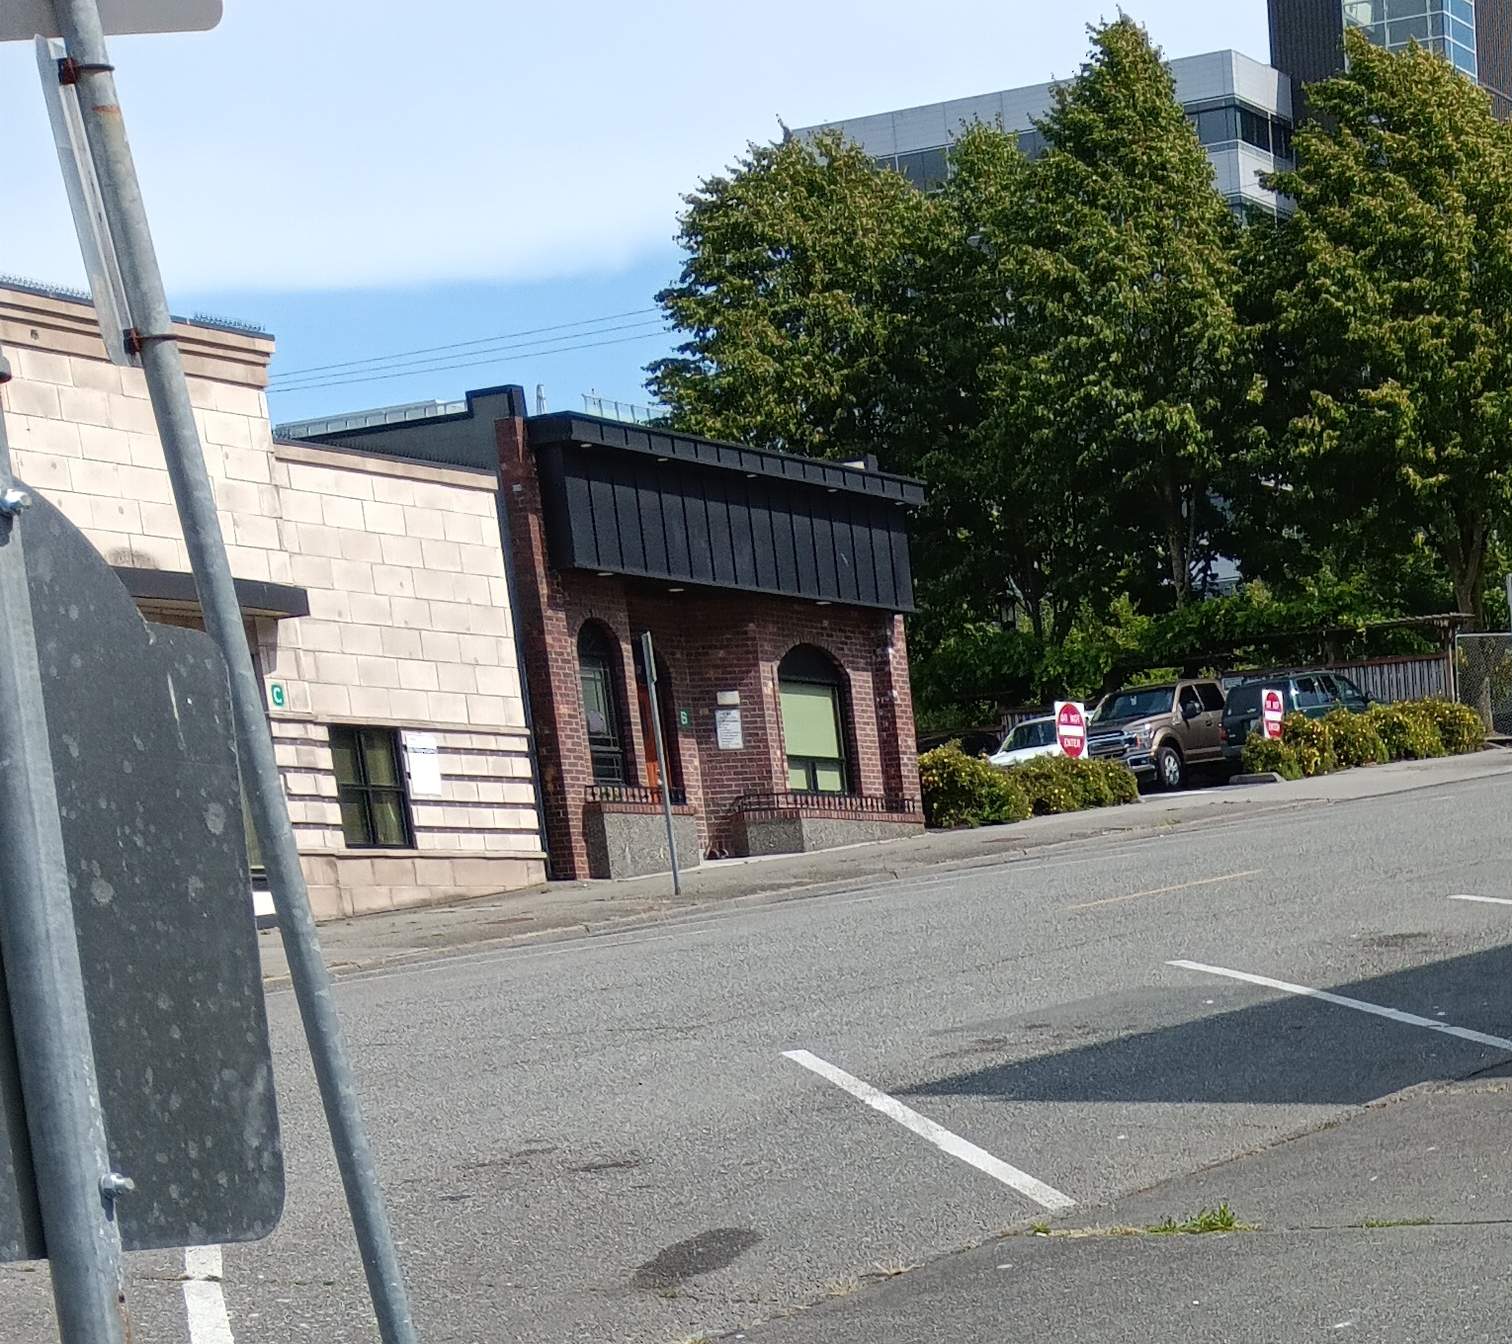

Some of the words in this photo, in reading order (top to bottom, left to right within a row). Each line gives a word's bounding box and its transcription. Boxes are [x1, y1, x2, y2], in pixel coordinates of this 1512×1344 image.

[273, 687, 282, 703] C
[1070, 713, 1080, 724] NOT
[1063, 737, 1081, 748] ENTER
